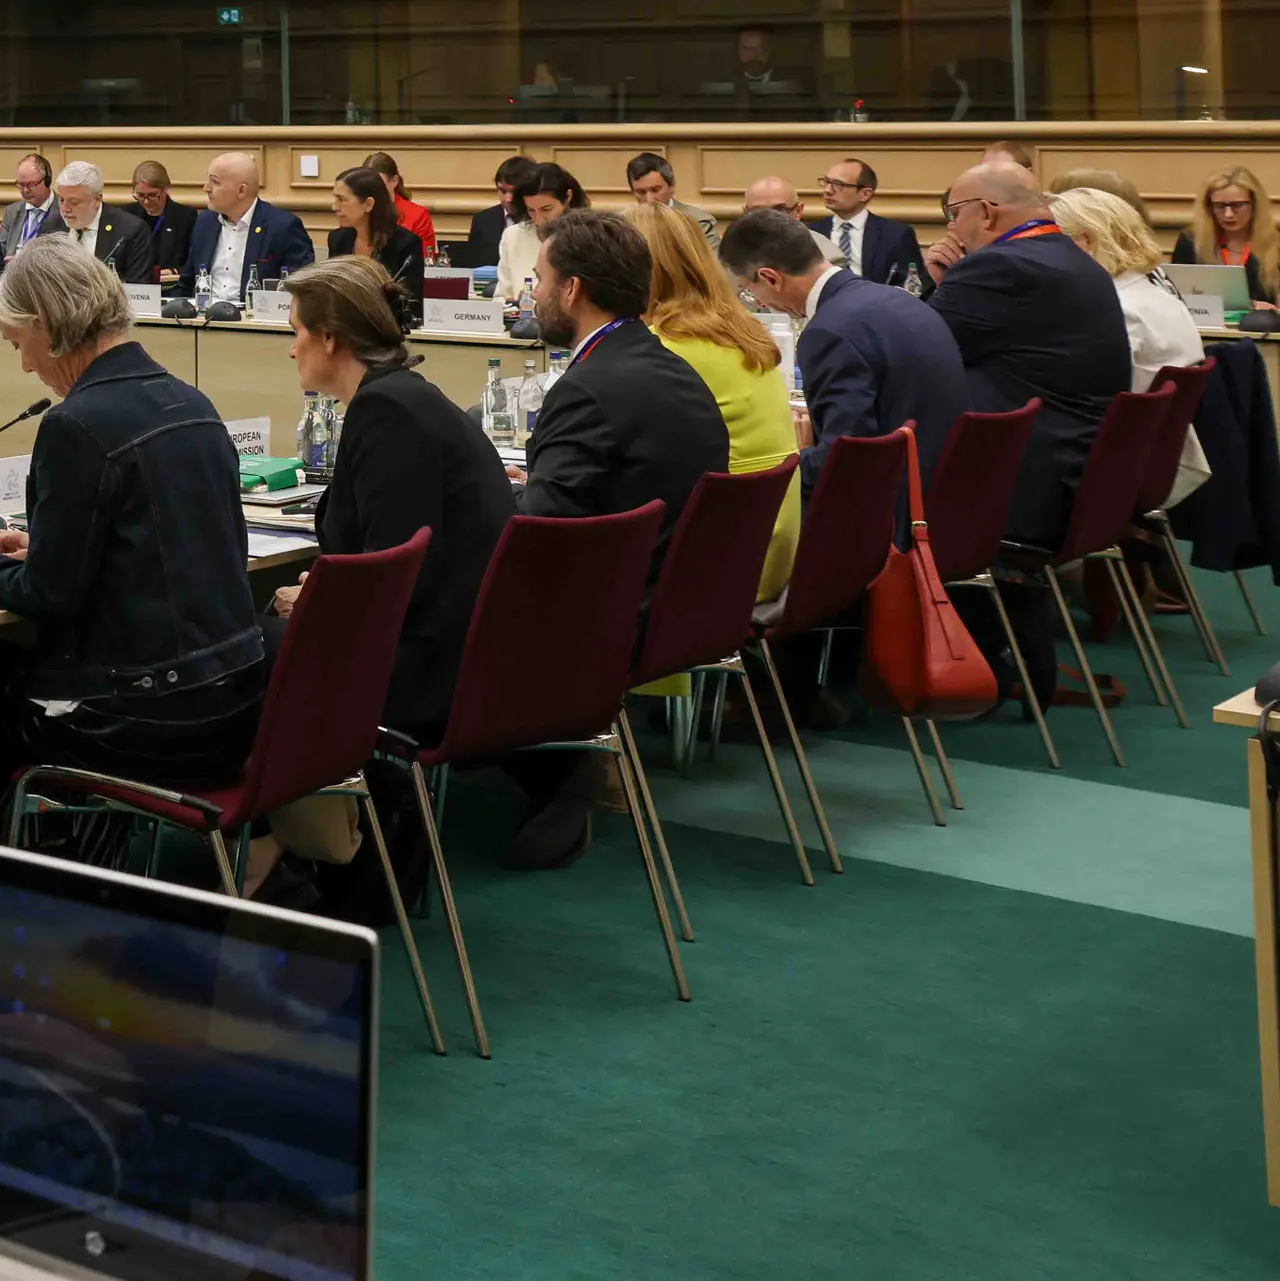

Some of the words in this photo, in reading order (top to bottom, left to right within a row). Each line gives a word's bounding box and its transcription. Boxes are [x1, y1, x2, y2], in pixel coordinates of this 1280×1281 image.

[454, 313, 491, 321] GERMANY
[229, 431, 261, 444] ROPEAN
[237, 445, 264, 455] ISSION
